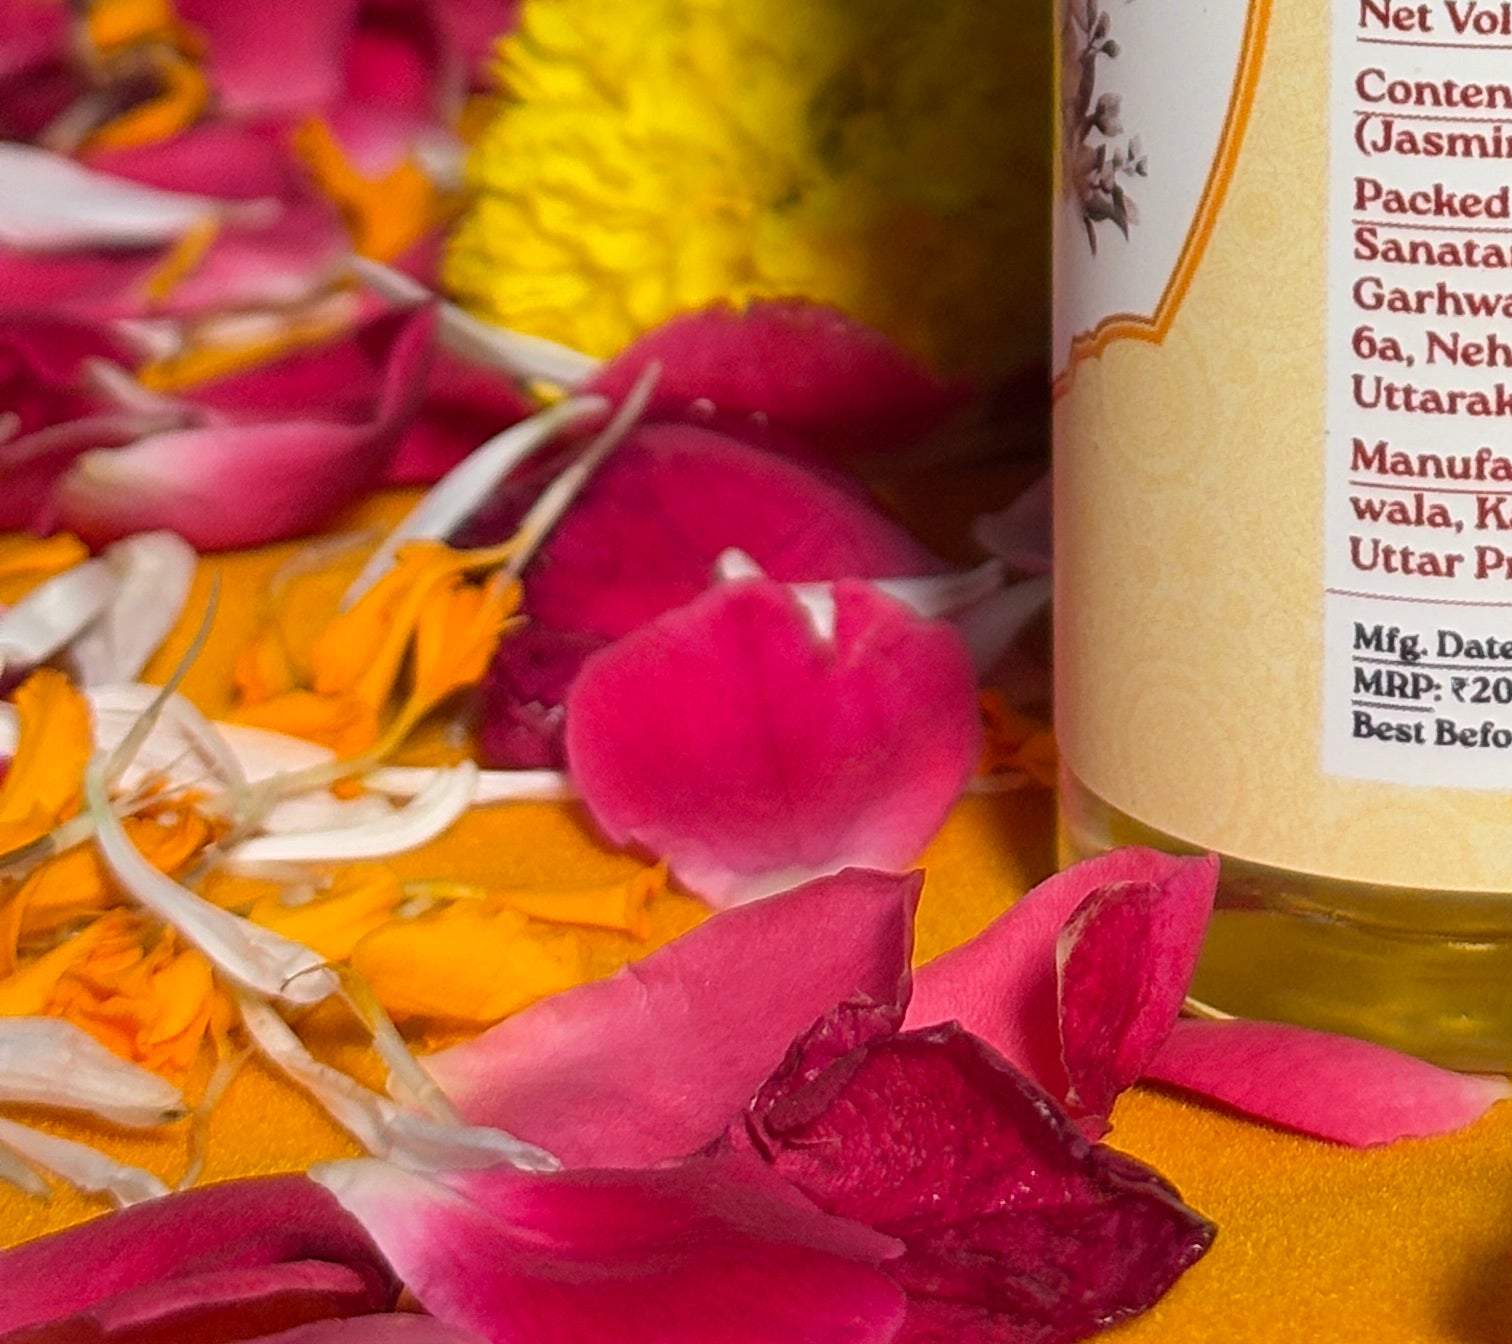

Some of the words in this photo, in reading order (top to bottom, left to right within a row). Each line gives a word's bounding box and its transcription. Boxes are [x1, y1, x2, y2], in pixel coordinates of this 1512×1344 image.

[1353, 177, 1509, 219] Packed
[1352, 325, 1415, 367] 6a,
[1349, 495, 1463, 533] wala,
[1349, 536, 1463, 579] Uttar
[1353, 622, 1429, 664] Mfg.
[1353, 667, 1442, 701] MRP:
[1353, 711, 1426, 746] Best
